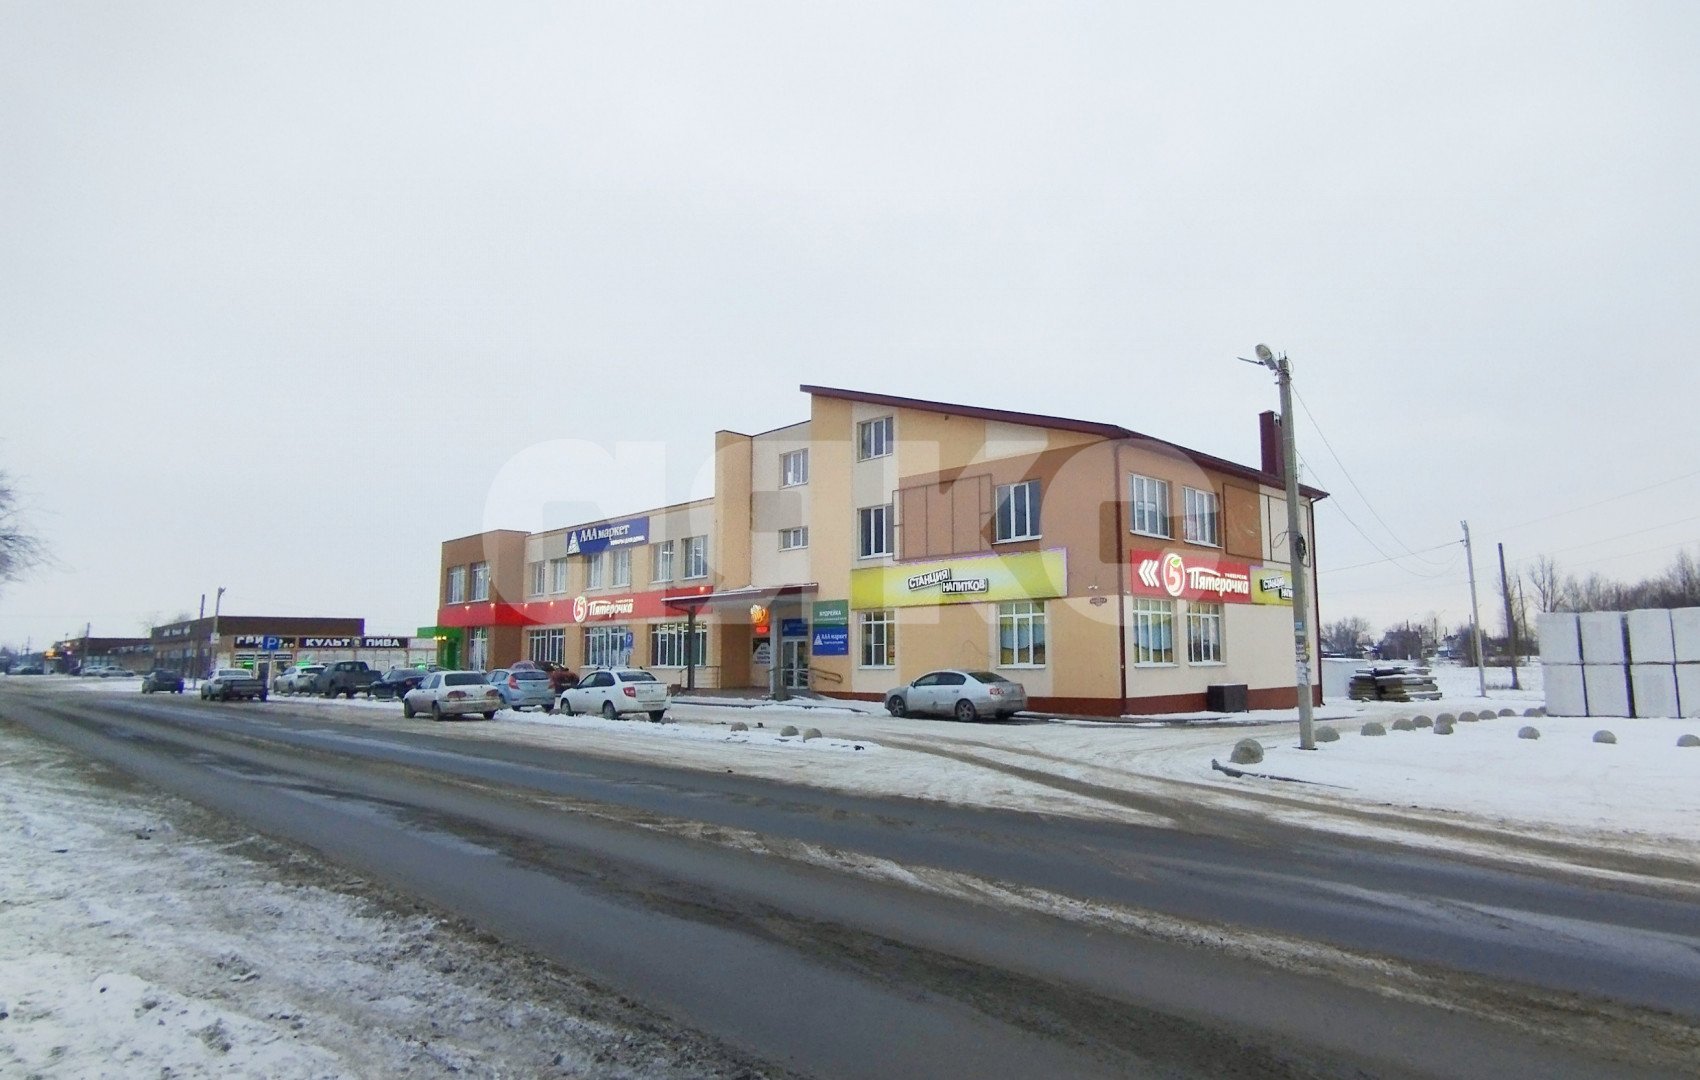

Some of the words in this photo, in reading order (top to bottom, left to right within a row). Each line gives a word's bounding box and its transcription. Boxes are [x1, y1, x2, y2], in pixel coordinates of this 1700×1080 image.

[598, 524, 630, 541] маркет
[909, 570, 948, 588] СТАНЦИЯ
[942, 579, 986, 592] НАПИТКОВ
[1186, 567, 1249, 596] Пятерочка
[588, 600, 633, 618] Пятерочка
[305, 638, 350, 647] КУЛЬТ
[365, 638, 400, 647] ПИВА
